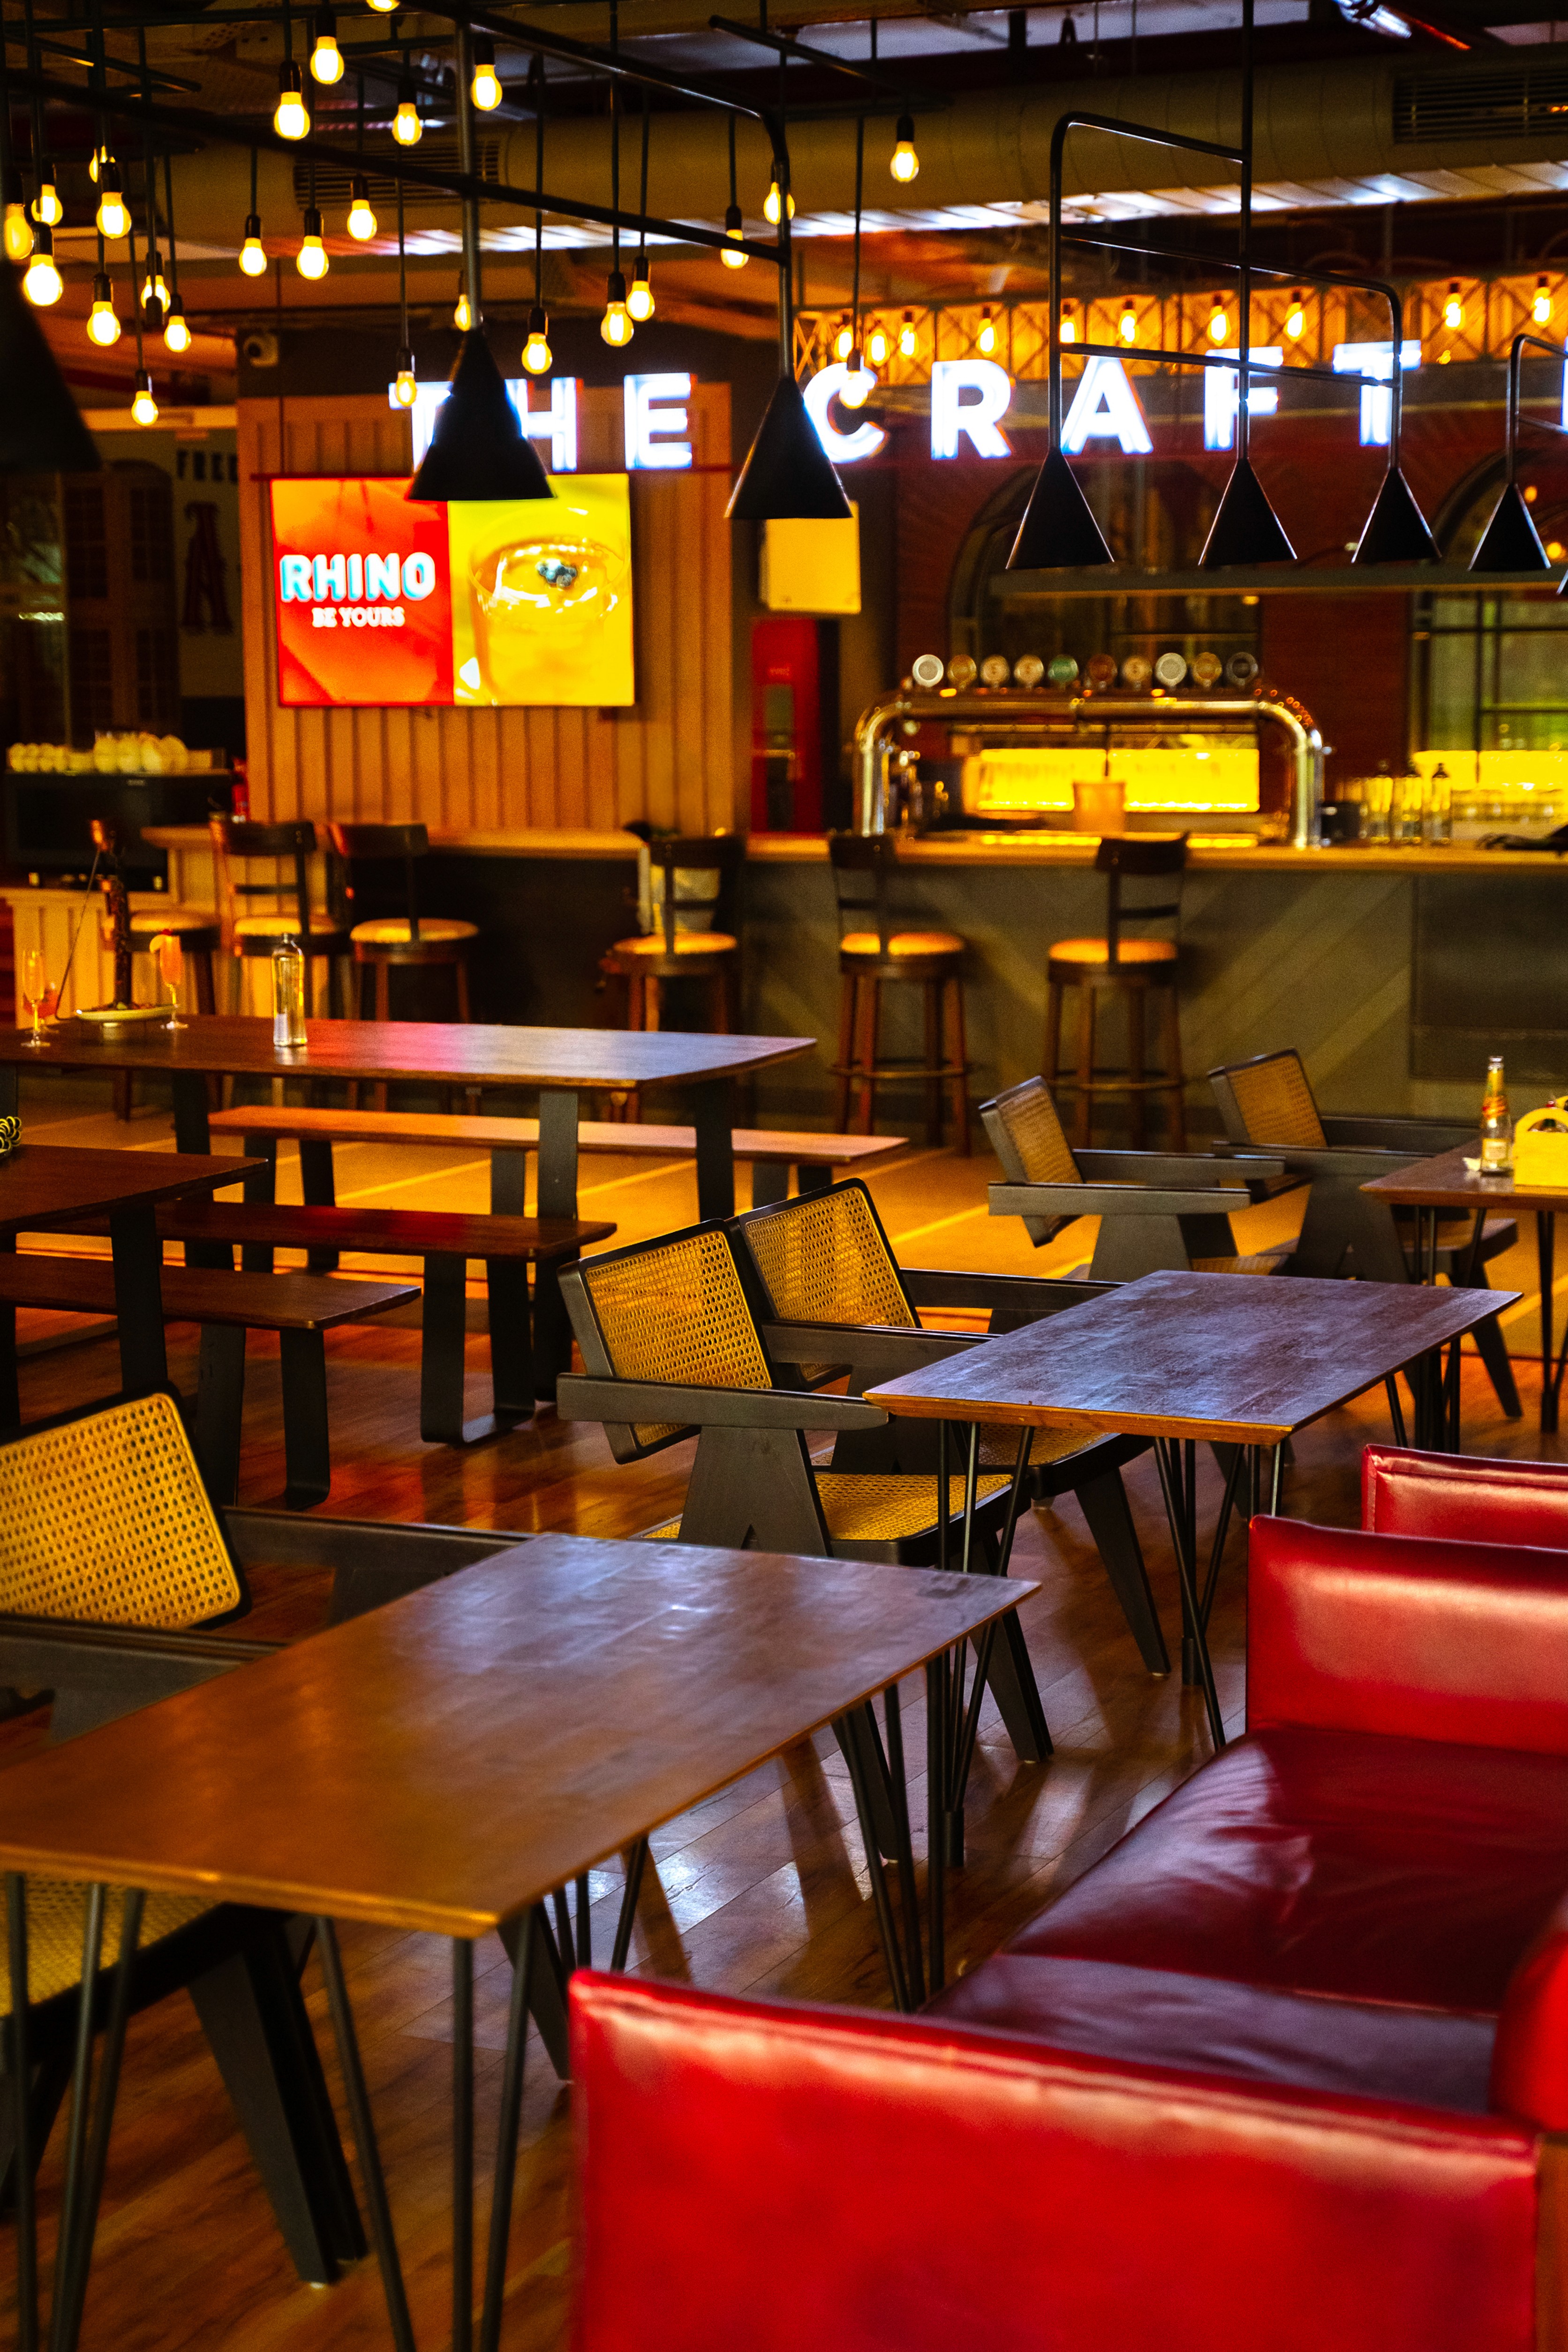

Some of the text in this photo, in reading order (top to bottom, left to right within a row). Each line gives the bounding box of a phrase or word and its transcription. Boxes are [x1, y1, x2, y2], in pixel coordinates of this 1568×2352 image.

[389, 340, 1421, 472] THE CRAFT
[279, 552, 436, 602] RHINO
[312, 606, 405, 628] BE YOURS
